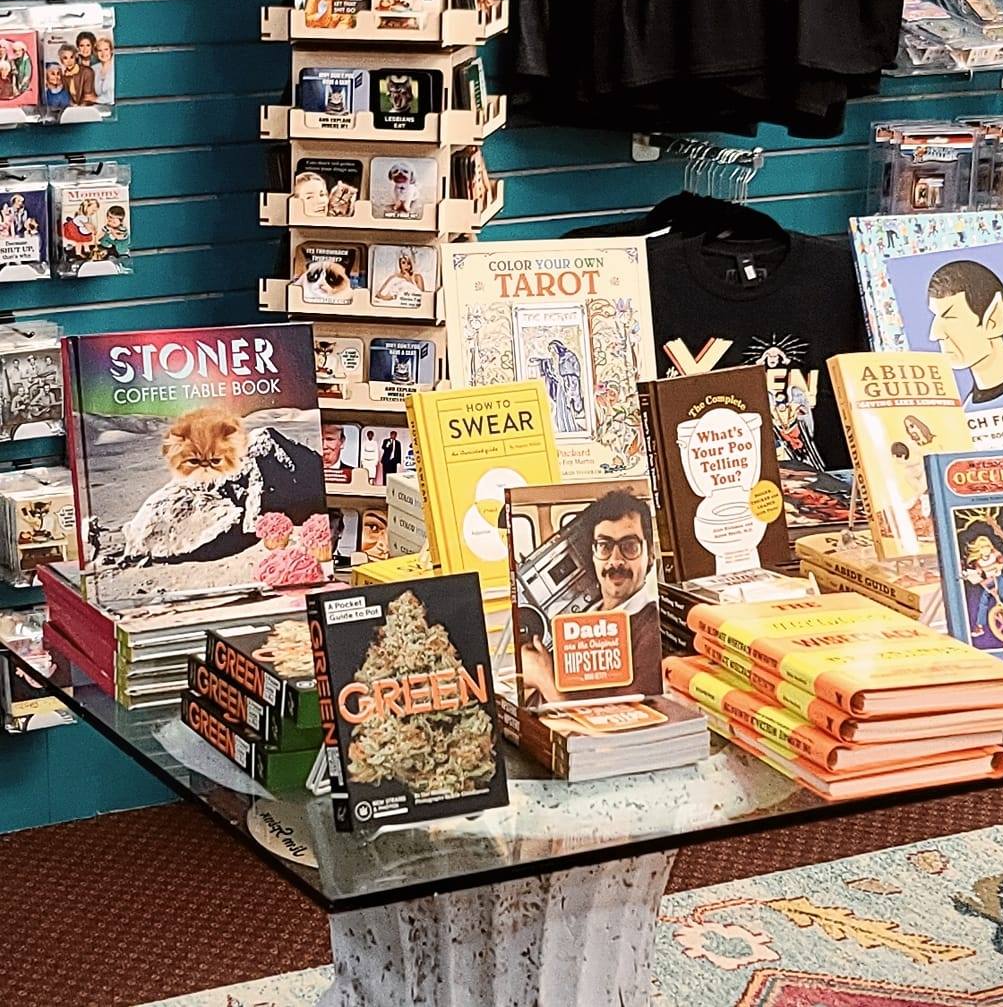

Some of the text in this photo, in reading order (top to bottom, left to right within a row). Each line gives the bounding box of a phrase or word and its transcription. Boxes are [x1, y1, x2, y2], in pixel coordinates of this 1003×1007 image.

[488, 258, 604, 272] COLOR YOUR OWN
[494, 270, 600, 298] TAROT
[109, 337, 279, 384] STONER
[860, 365, 942, 382] ABIDE
[113, 378, 281, 404] COFFEE TABLE BOOK
[864, 381, 947, 398] GUIDE
[466, 400, 511, 413] HOW TO
[688, 395, 746, 418] The Complete
[449, 411, 533, 440] SWEAR
[697, 426, 743, 444] What's
[691, 441, 752, 460] Your Poo
[700, 456, 749, 473] Telling
[710, 471, 742, 486] You?
[834, 563, 897, 598] ABIDE GUIDE
[329, 612, 353, 621] Guide
[365, 609, 379, 617] Pot
[335, 600, 362, 609] Pocket
[563, 619, 618, 641] Dads
[215, 641, 265, 697] GREEN
[564, 648, 622, 674] HIPSTERS
[197, 666, 247, 722] GREEN
[310, 620, 337, 745] GREEN
[338, 664, 488, 725] GREEN
[188, 702, 235, 760] GREEN
